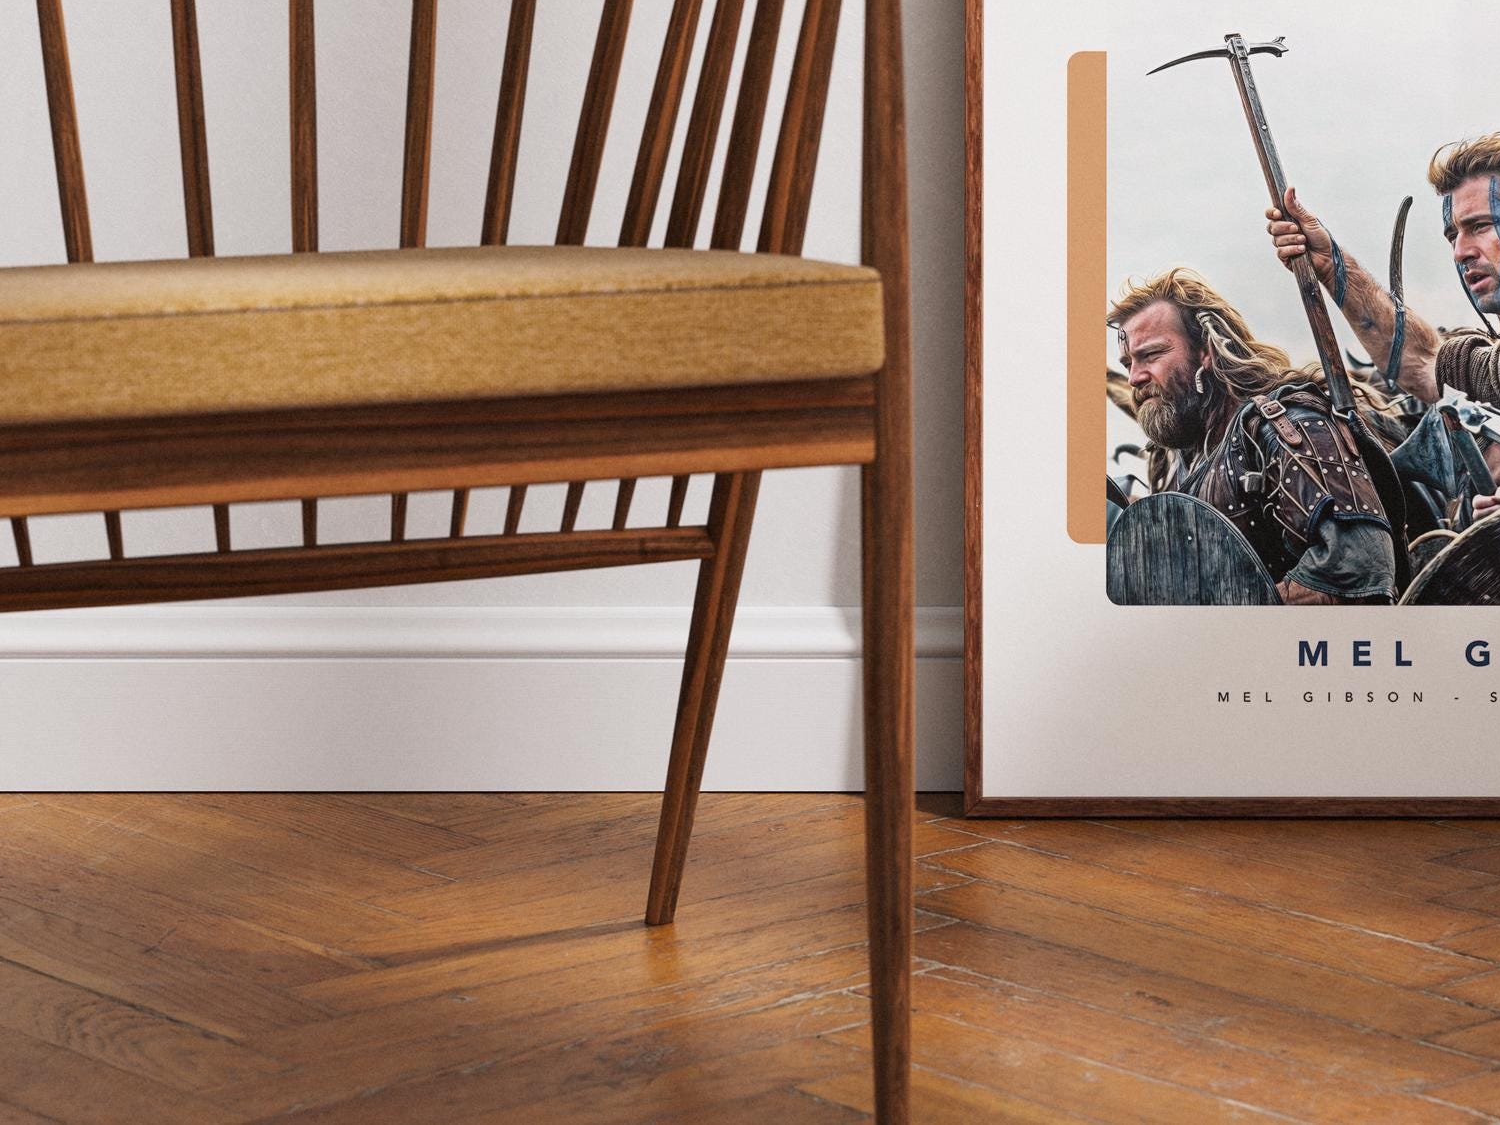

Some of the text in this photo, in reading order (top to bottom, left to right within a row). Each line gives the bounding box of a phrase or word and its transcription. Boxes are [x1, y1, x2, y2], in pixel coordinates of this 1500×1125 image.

[1298, 640, 1413, 667] MEL
[1217, 691, 1273, 703] MEL
[1302, 690, 1424, 703] GIBSON
